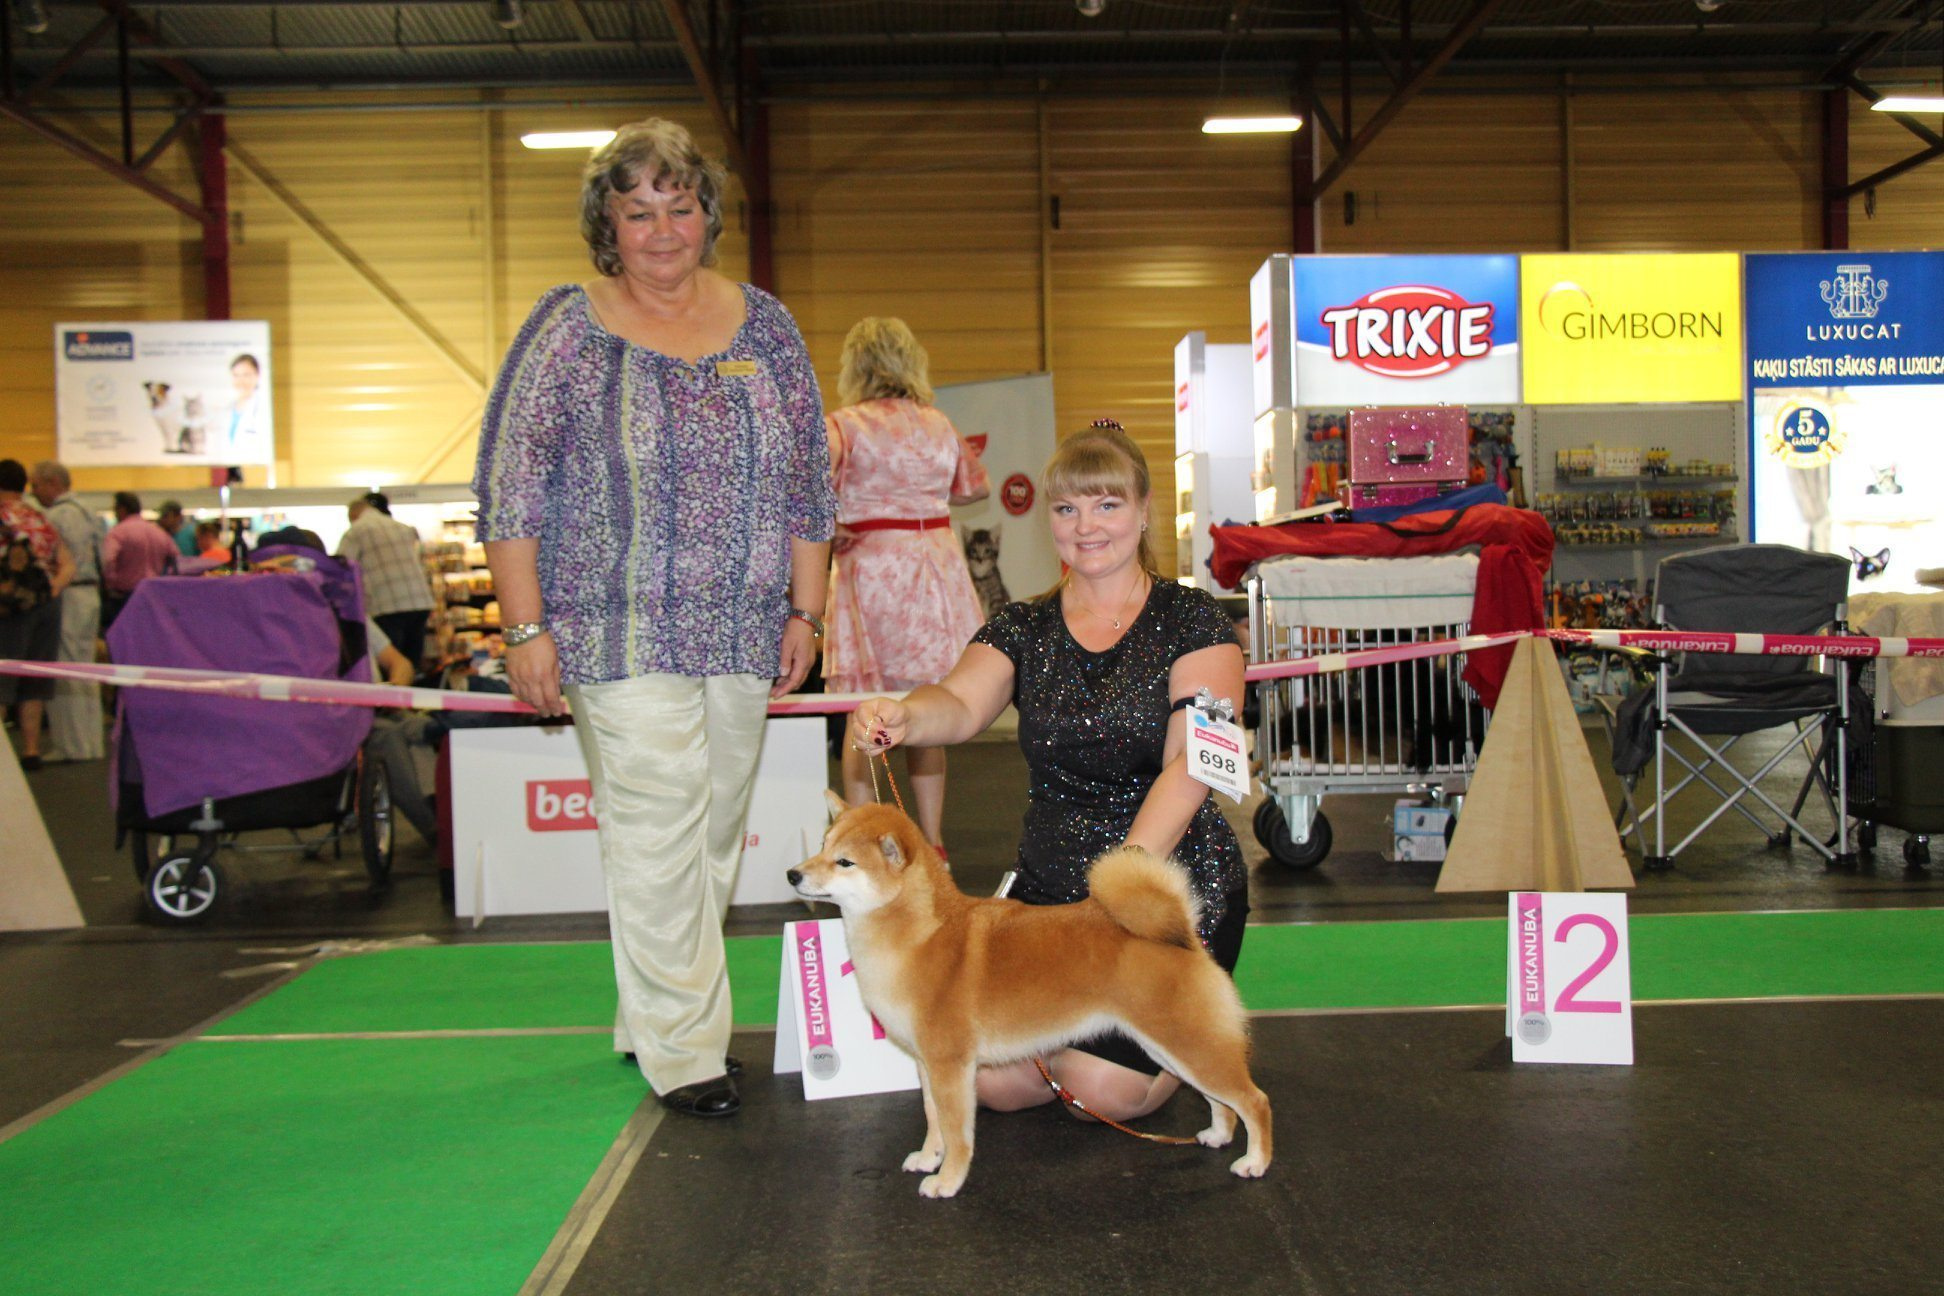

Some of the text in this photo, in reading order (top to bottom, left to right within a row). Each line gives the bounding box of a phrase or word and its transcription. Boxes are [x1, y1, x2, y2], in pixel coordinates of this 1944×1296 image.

[1323, 304, 1492, 360] TRIXIE
[1562, 311, 1723, 340] GIMBORN
[1806, 323, 1902, 341] LUXUCAT
[1753, 358, 1788, 382] KAĶU
[1789, 354, 1833, 377] STĀSTI
[1835, 353, 1877, 377] SĀKAS
[1878, 356, 1897, 376] AR
[1797, 409, 1815, 437] 5
[1200, 749, 1236, 774] 698
[1523, 907, 1540, 1003] EUKANUBA
[1553, 913, 1623, 1014] 2
[803, 936, 826, 1036] EUKANUBA
